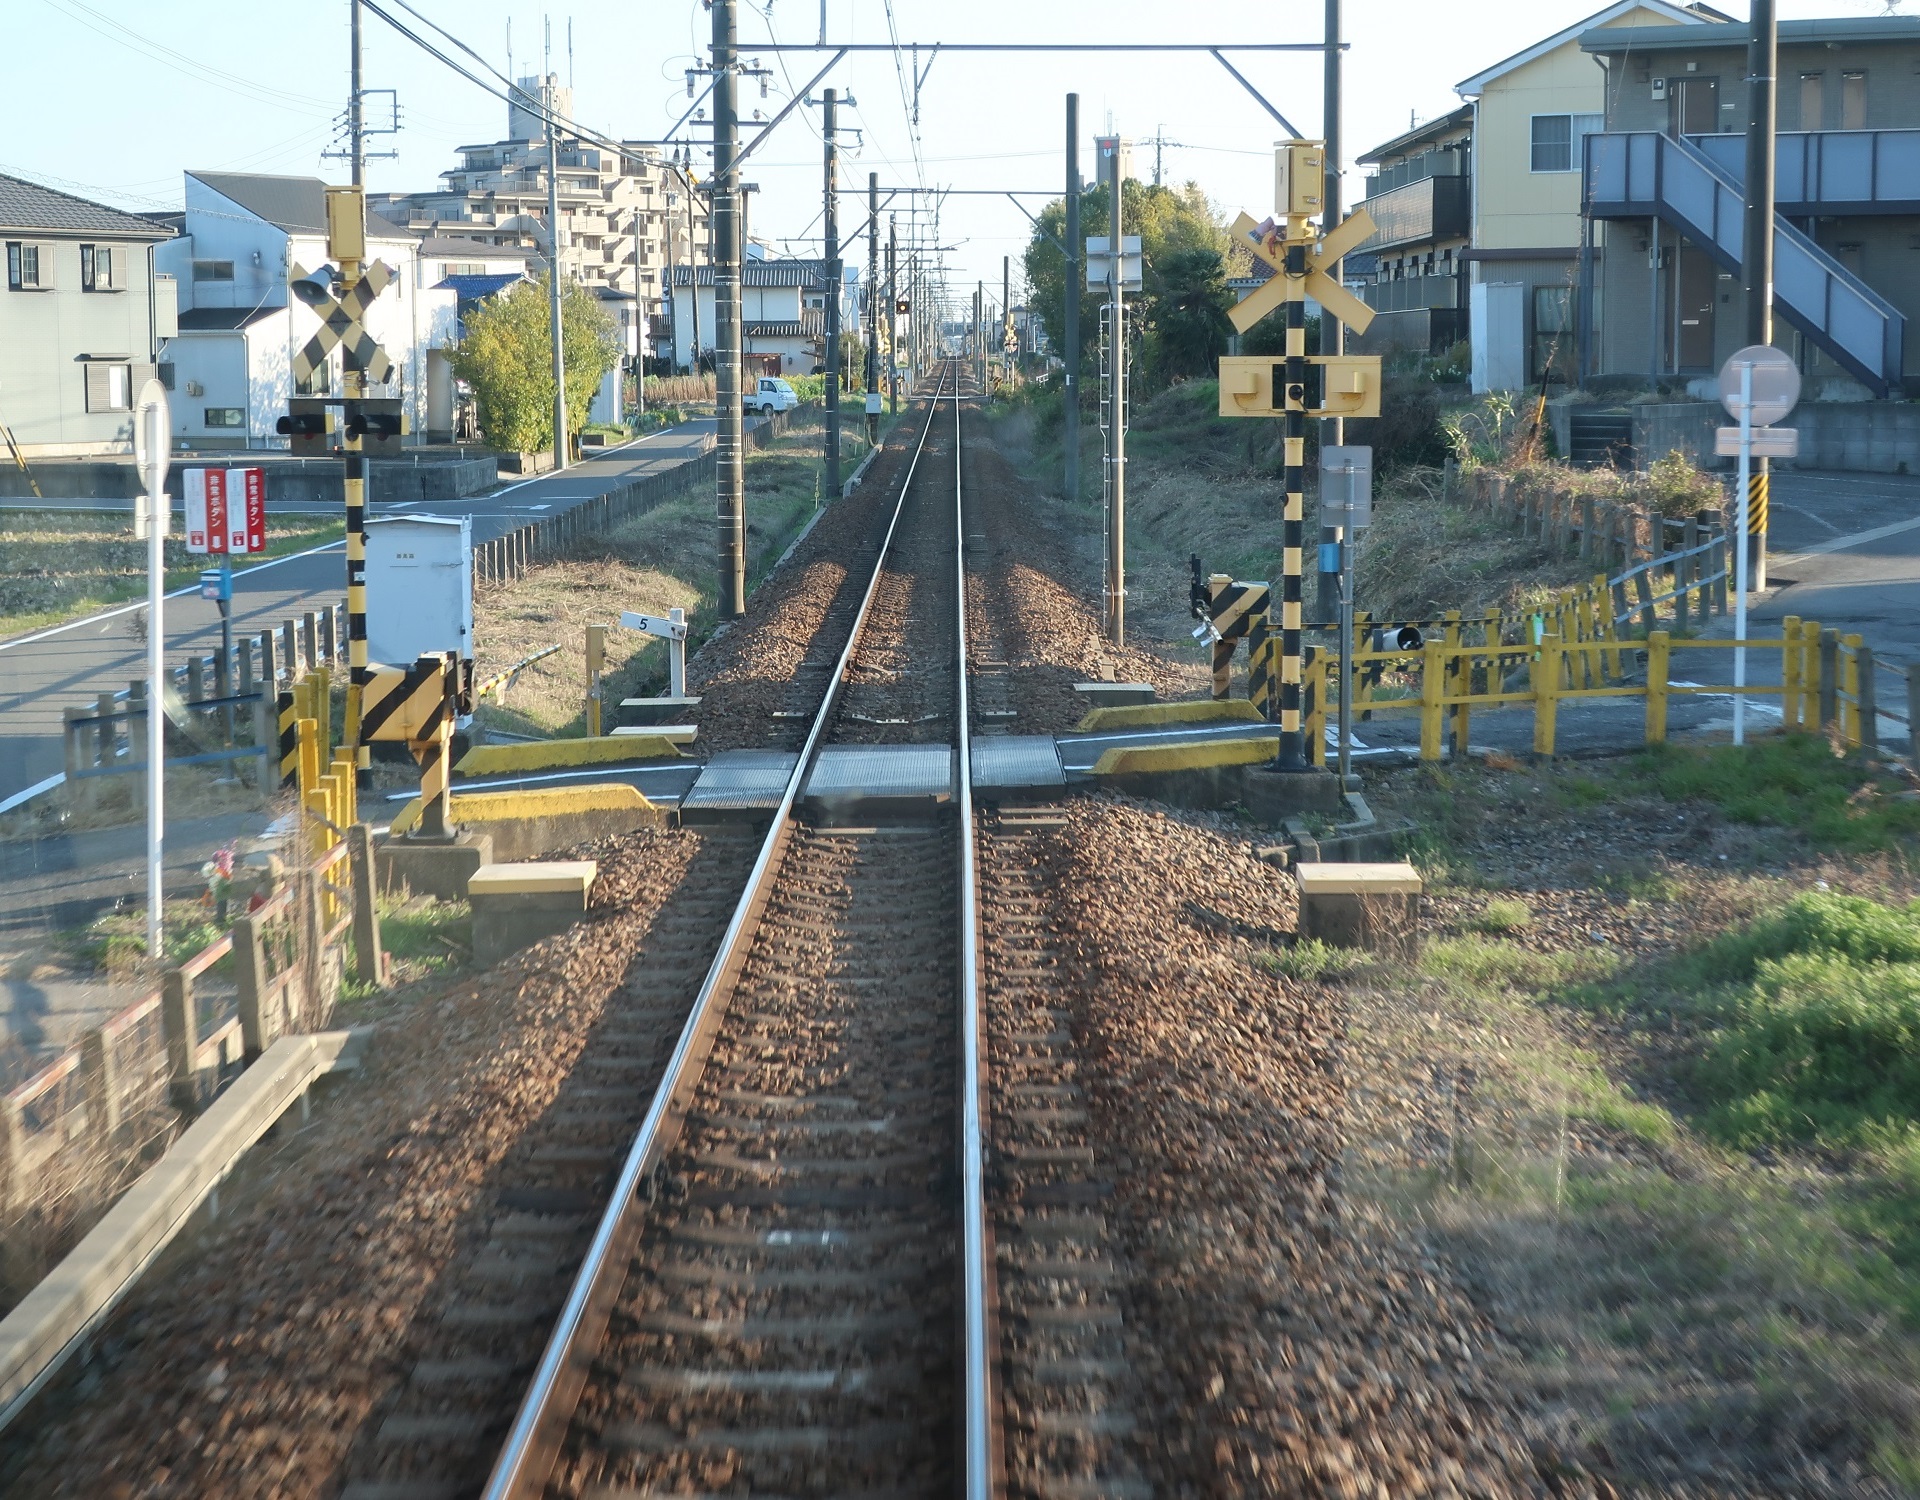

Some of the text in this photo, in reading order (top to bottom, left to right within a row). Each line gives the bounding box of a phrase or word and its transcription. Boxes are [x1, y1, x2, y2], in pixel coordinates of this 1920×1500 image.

[210, 474, 221, 527] 非常ボタン
[248, 474, 260, 527] 非常ボタン
[639, 618, 648, 630] 5
